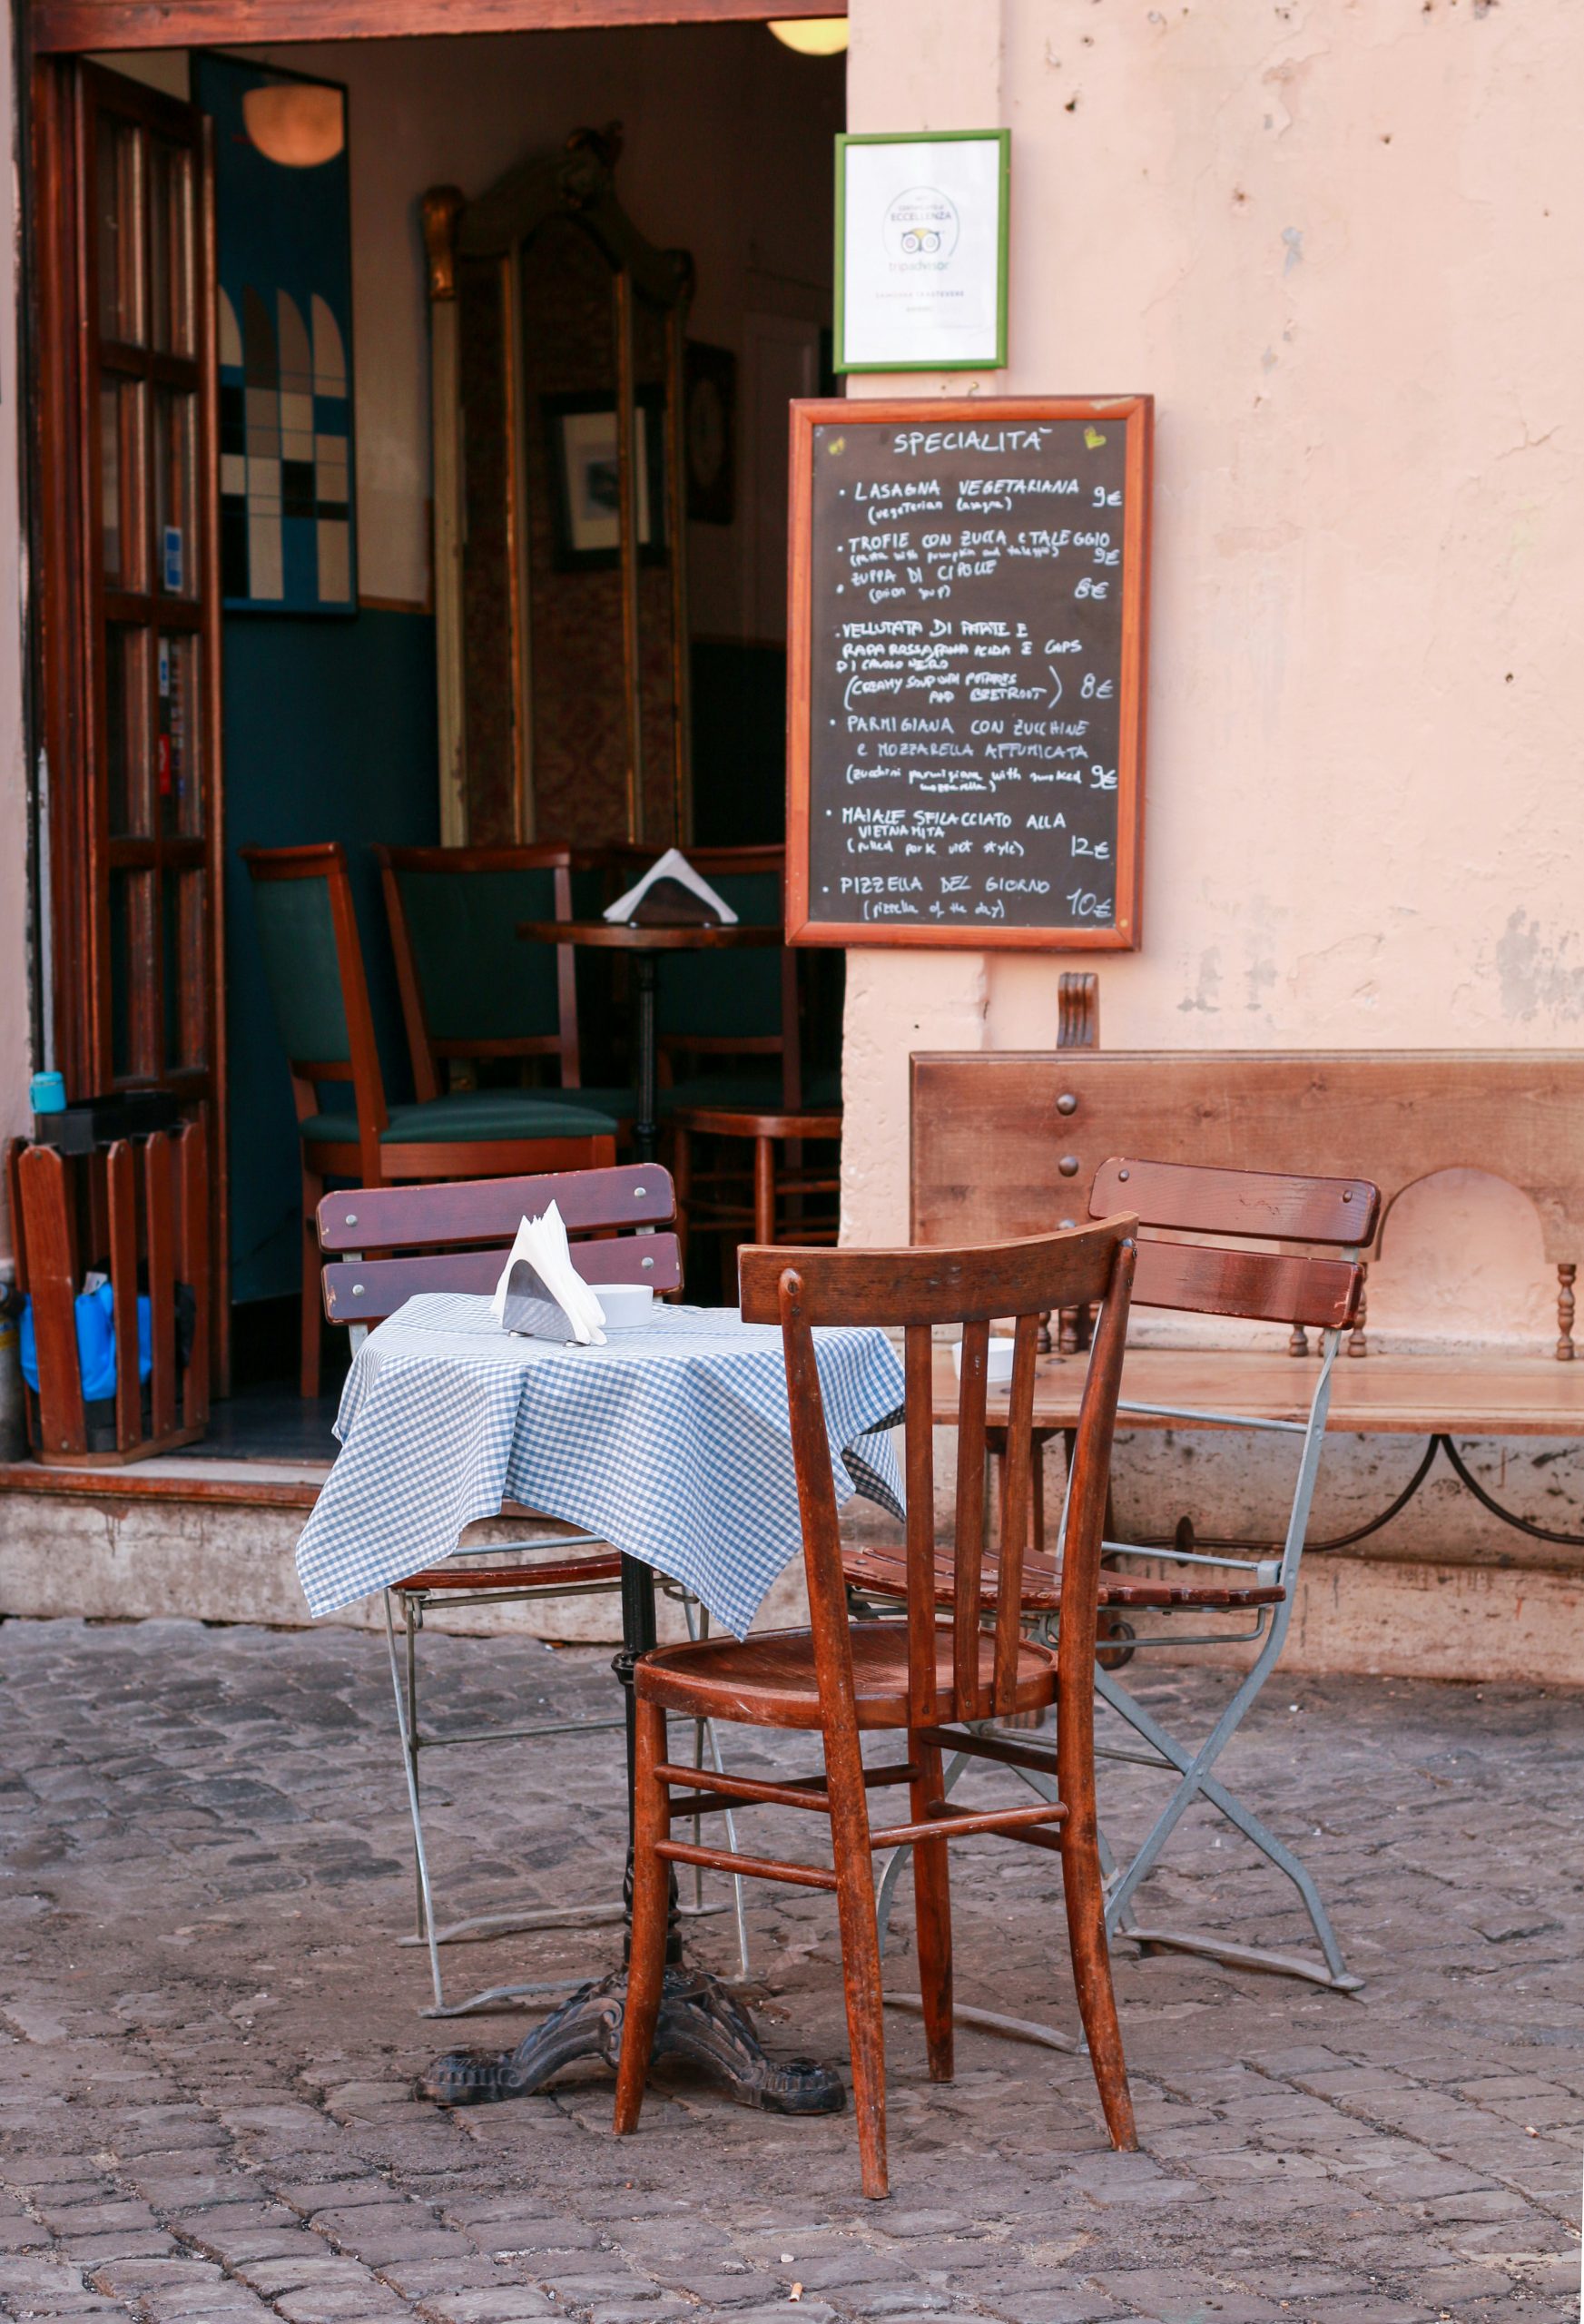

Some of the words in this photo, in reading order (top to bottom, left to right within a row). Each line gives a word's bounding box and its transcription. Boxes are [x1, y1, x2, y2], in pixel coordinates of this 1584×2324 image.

[890, 211, 952, 222] ECCELLENZA
[889, 260, 950, 272] tripadvisor
[855, 480, 940, 500] LASAGNA
[959, 479, 1079, 496] VEGETARIANA
[1093, 487, 1122, 507] 9€
[848, 533, 910, 552] TROFIE
[922, 534, 952, 548] CON
[960, 530, 1007, 547] ZUCCA
[1028, 530, 1110, 547] TALEGGIO
[893, 550, 919, 562] with
[927, 548, 977, 564] pumpkin
[982, 548, 1000, 558] and
[1093, 548, 1120, 566] 9€
[851, 567, 897, 586] ZUPPA
[908, 566, 923, 583] DI
[842, 620, 923, 637] VELLUTATA
[930, 619, 952, 636] DI
[961, 622, 1010, 636] PATATE
[1017, 623, 1028, 636] E
[842, 644, 885, 658] RAPA
[1021, 642, 1033, 655] E
[836, 661, 857, 673] DI
[908, 658, 949, 671] NERO
[929, 691, 954, 704] AND
[1081, 674, 1113, 699] 8€
[848, 716, 954, 734] PARMIGIANA
[970, 719, 1003, 734] CON
[1013, 720, 1089, 736] ZUCCHINE
[879, 743, 973, 757] MOZZARELLA
[985, 743, 1088, 758] AFFUMICATA
[991, 767, 1021, 782] with
[1090, 764, 1117, 789] 9€
[842, 807, 906, 824] MAIALE
[913, 810, 1011, 828] SFILACCIATO
[1027, 813, 1066, 830] ALLA
[858, 825, 945, 839] VIETNAMITA
[1070, 836, 1110, 859] 12€
[841, 878, 922, 893] PIZZELLA
[941, 877, 970, 892] DEL
[986, 878, 1050, 893] GIORNO
[1067, 888, 1111, 917] 10€
